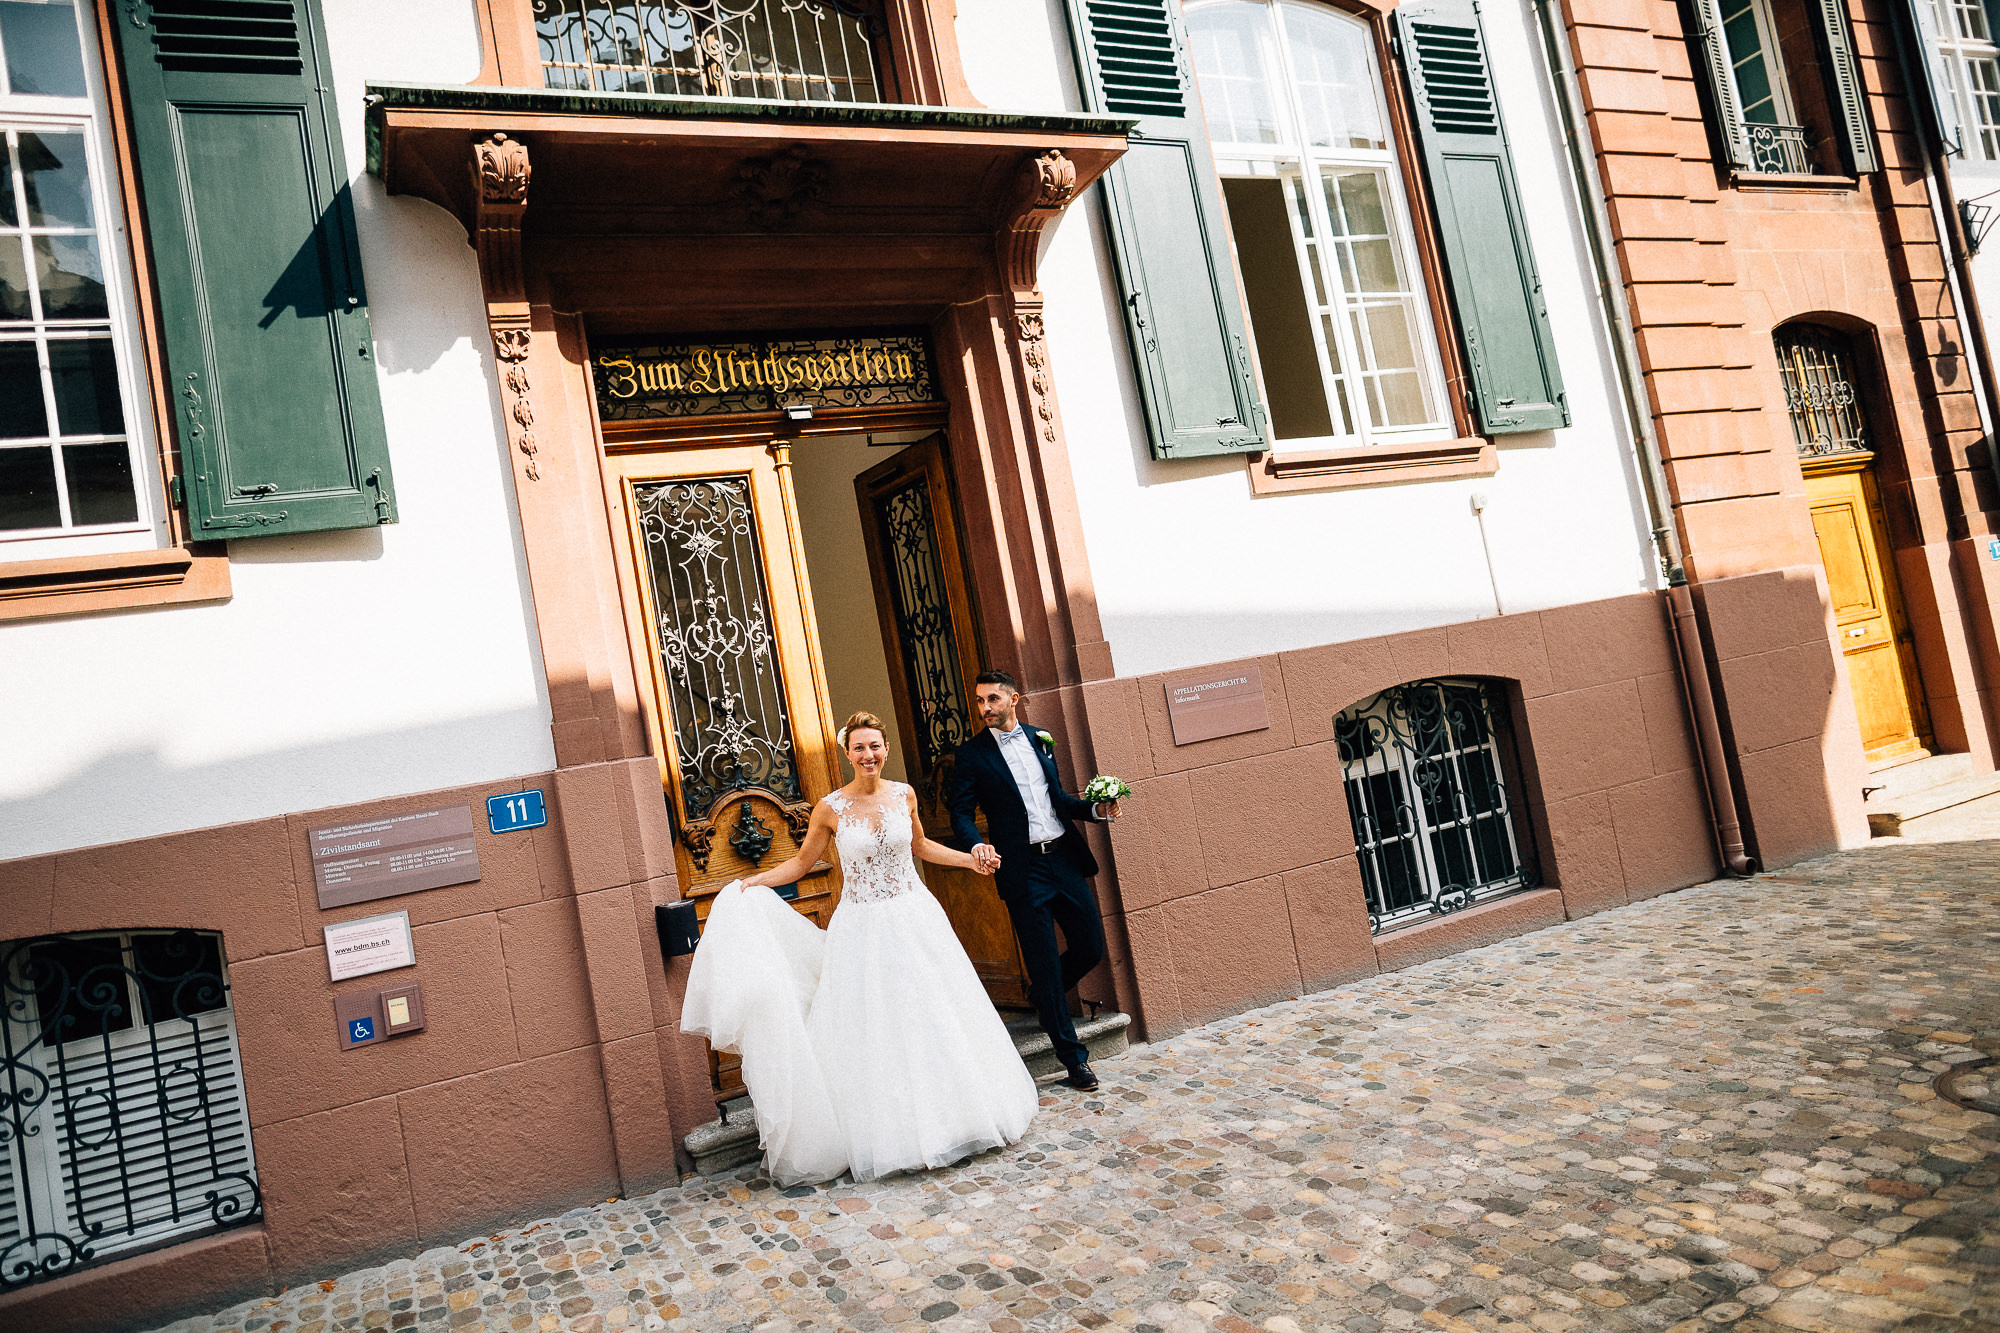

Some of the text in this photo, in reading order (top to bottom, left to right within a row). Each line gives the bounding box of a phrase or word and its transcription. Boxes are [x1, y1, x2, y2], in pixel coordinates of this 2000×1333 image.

[600, 345, 915, 398] Zum Ulrichsgärtlein
[1173, 676, 1248, 696] APPELLATIONSGERICHT BS
[1174, 693, 1200, 704] Informatik
[506, 798, 528, 823] 11
[372, 824, 393, 832] Migration
[320, 839, 381, 856] Zivilstandsamt
[325, 871, 346, 879] Mittwoch
[326, 876, 351, 884] Donnerstag
[334, 939, 390, 955] www.bdm.bs.ch
